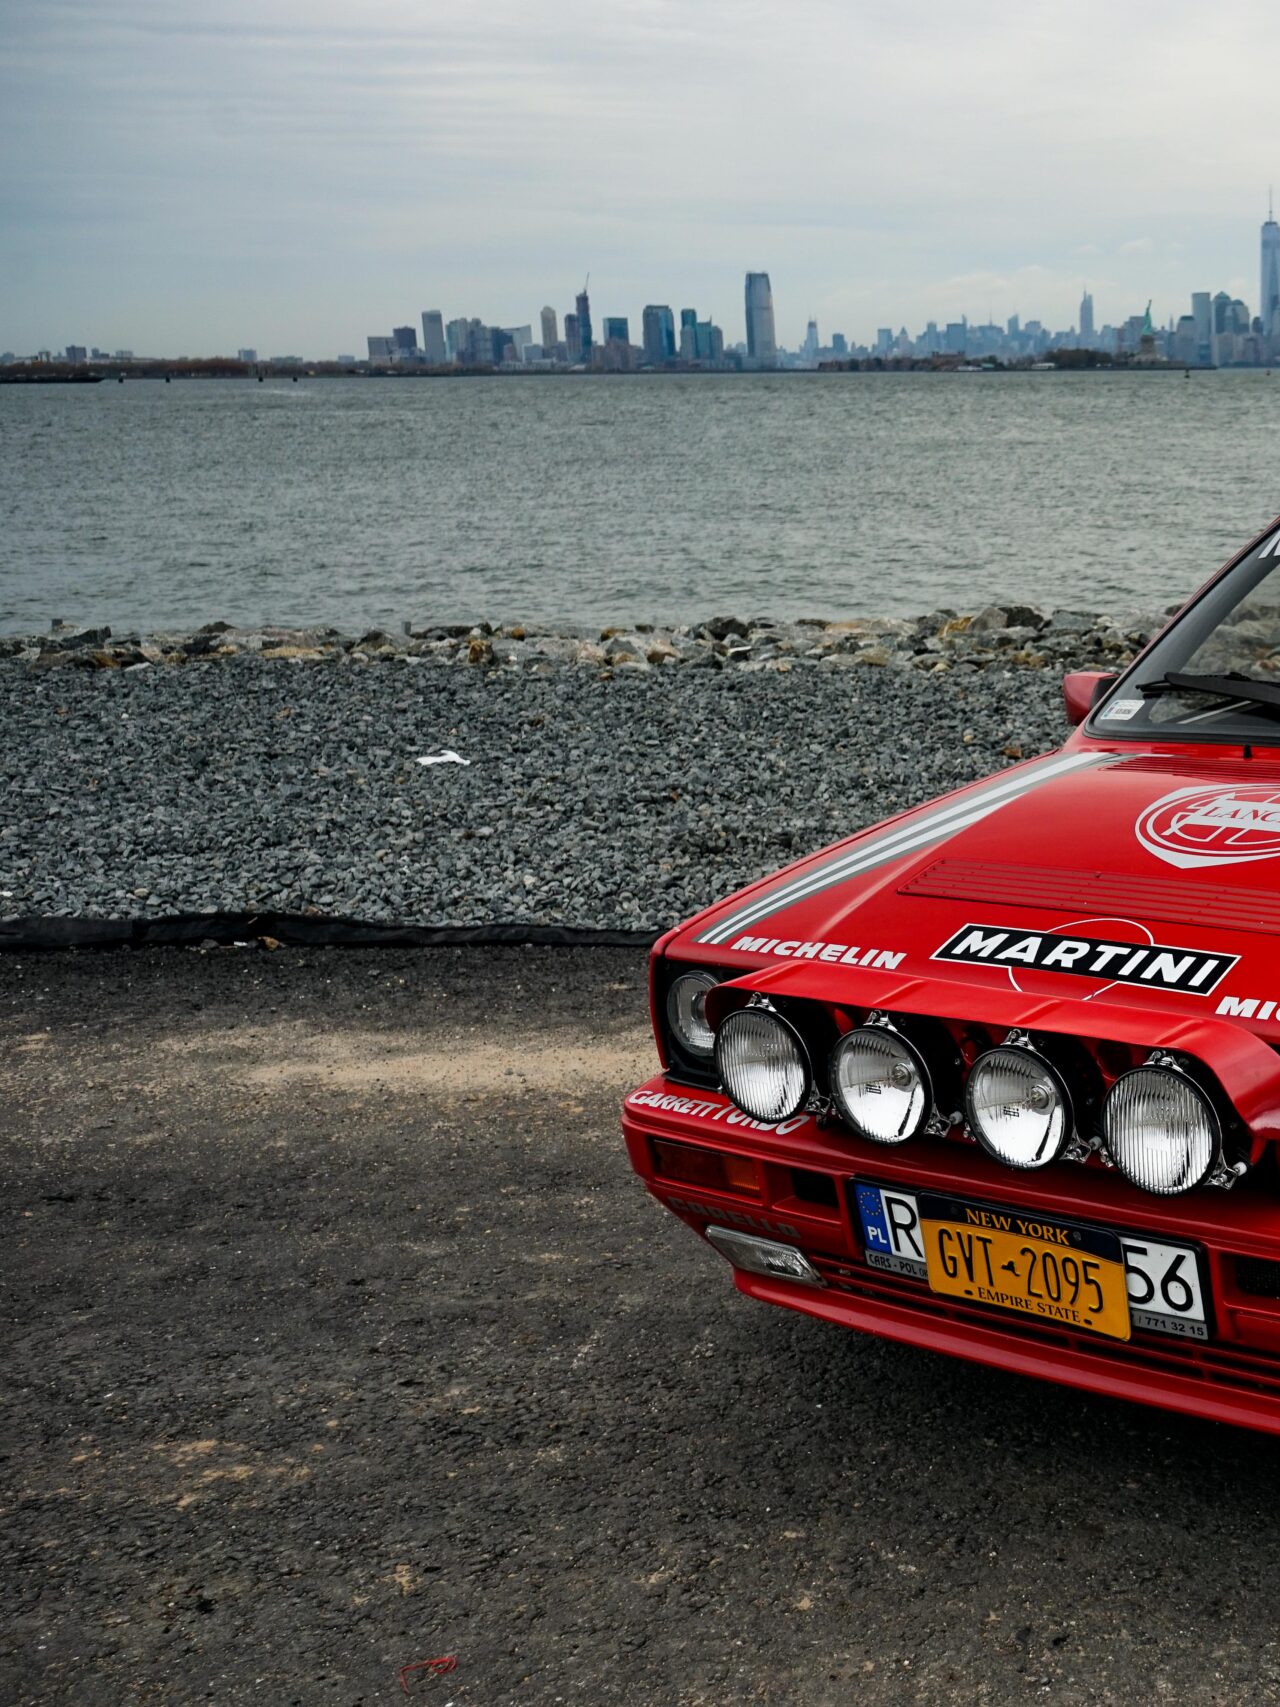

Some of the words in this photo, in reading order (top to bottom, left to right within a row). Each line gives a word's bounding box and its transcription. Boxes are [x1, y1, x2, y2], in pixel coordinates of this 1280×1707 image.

[730, 935, 908, 970] MICHELIN
[950, 929, 1222, 988] MARTINI
[628, 1090, 723, 1117] GARRETT
[667, 1195, 802, 1239] CARELLO
[867, 1225, 888, 1245] PL
[964, 1207, 1013, 1232] NEW
[1019, 1219, 1071, 1247] YORK
[869, 1253, 892, 1268] CARS
[899, 1261, 917, 1275] POL
[885, 1195, 924, 1258] R
[1122, 1243, 1194, 1312] 56
[938, 1227, 995, 1287] GVT
[1020, 1247, 1104, 1313] 2095
[977, 1286, 1033, 1312] EMPIRE
[1037, 1301, 1081, 1324] STATE
[1145, 1316, 1166, 1329] 771
[1171, 1321, 1186, 1333] 32
[1189, 1325, 1204, 1336] 15
